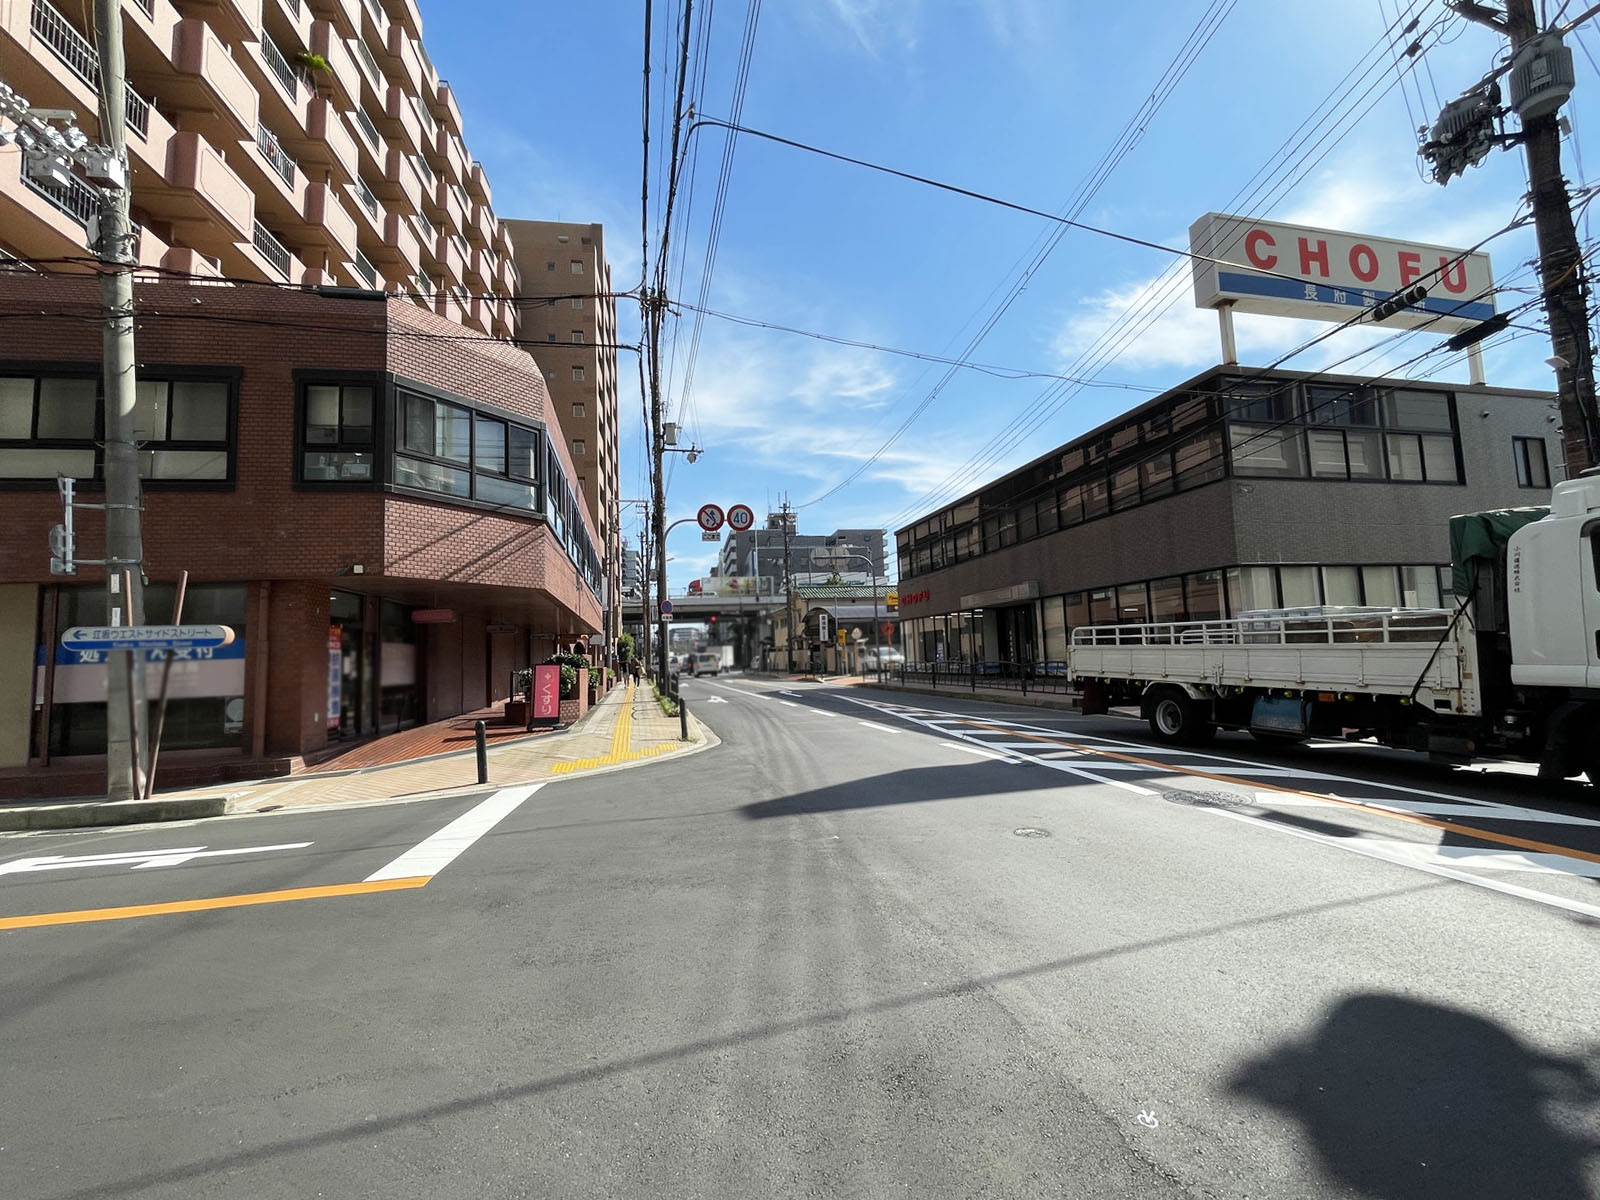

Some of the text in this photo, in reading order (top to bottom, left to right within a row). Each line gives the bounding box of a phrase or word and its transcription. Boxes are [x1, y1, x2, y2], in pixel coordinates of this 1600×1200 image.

[1244, 229, 1468, 294] CHOFU
[1304, 284, 1427, 313] 長府製所
[733, 512, 748, 524] 40
[541, 683, 553, 716] くすり
